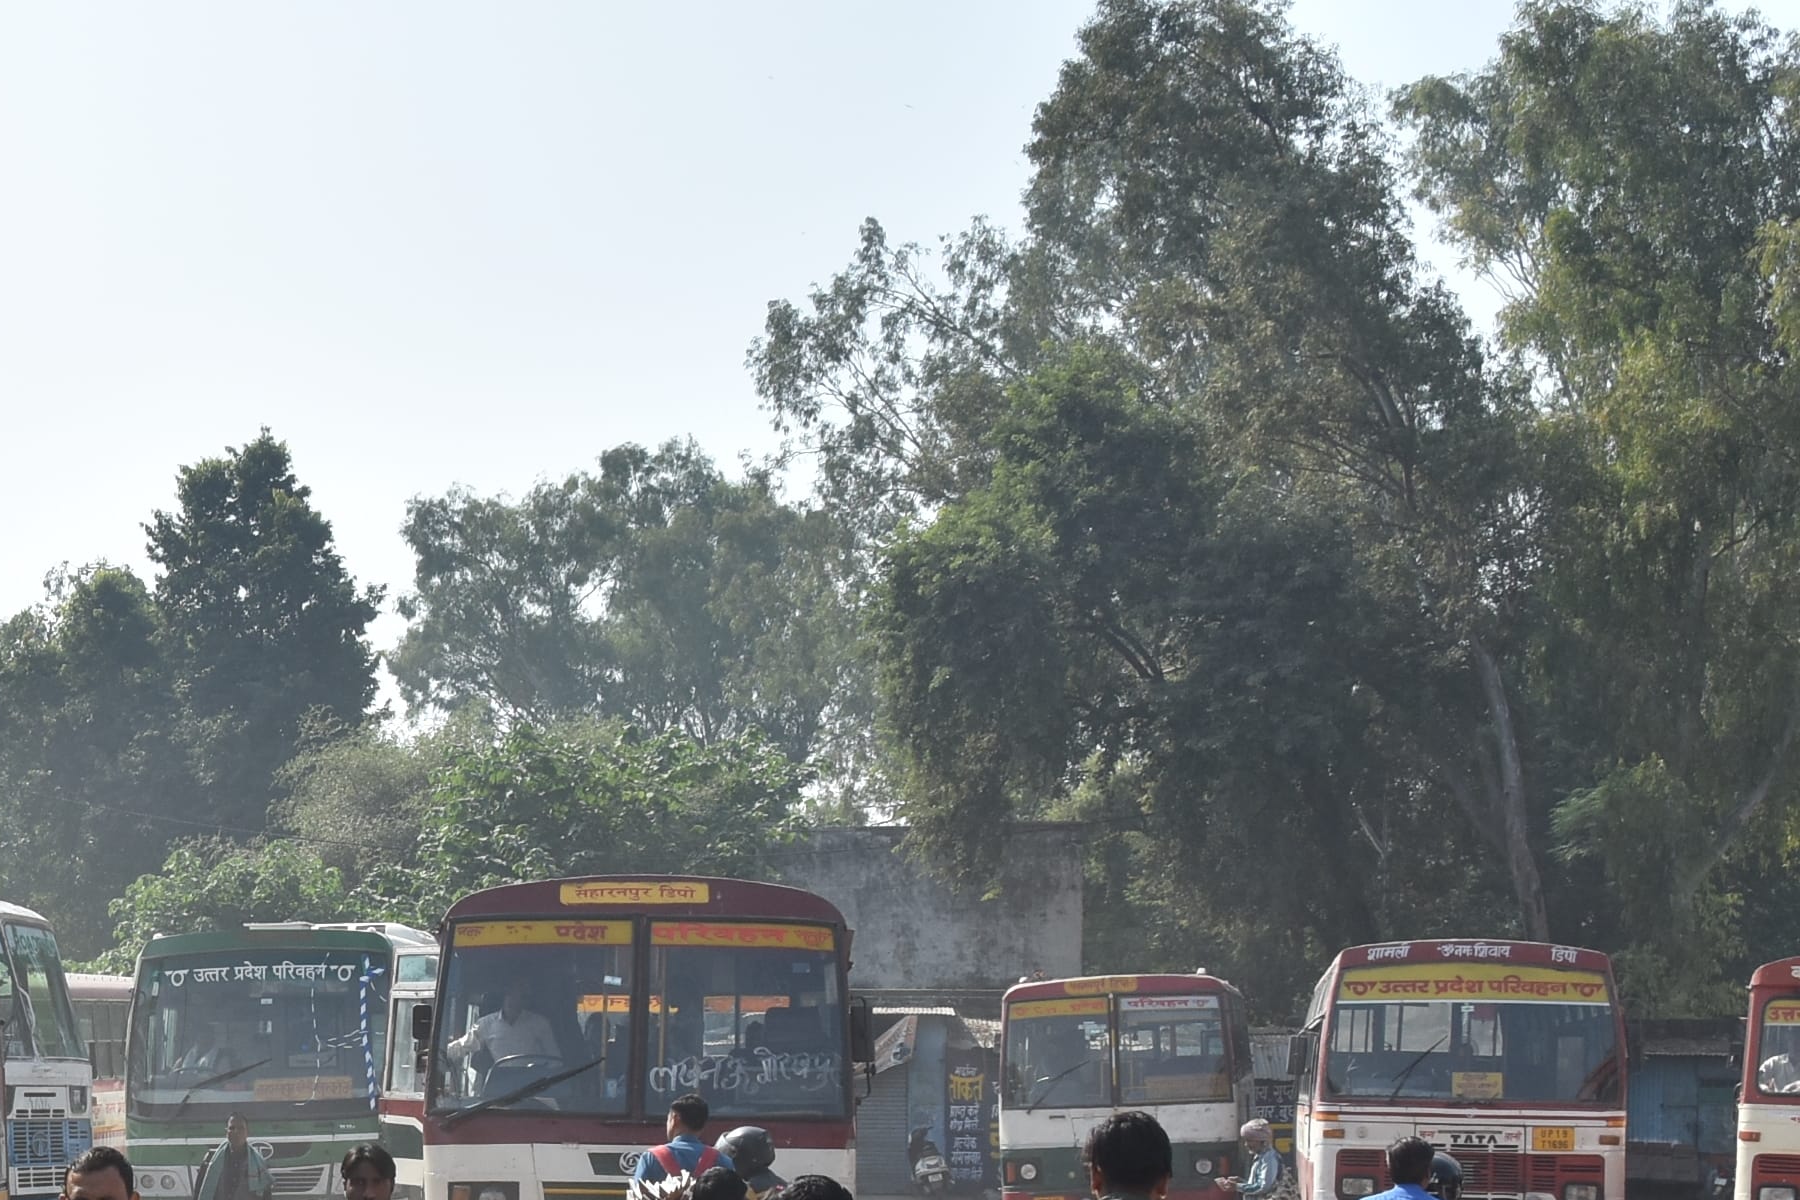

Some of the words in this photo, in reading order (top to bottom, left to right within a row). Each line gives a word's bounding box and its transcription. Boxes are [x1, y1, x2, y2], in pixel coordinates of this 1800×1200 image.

[651, 921, 788, 944] परिवहन
[1474, 943, 1511, 958] शिवाय
[193, 966, 230, 983] उत्तर
[233, 960, 268, 981] प्रदेश
[271, 960, 327, 981] परिवहन
[1378, 980, 1431, 994] उत्तर
[1434, 975, 1484, 995] प्रदेश
[1488, 975, 1567, 996] परिवहन
[1450, 1134, 1498, 1144] TATA
